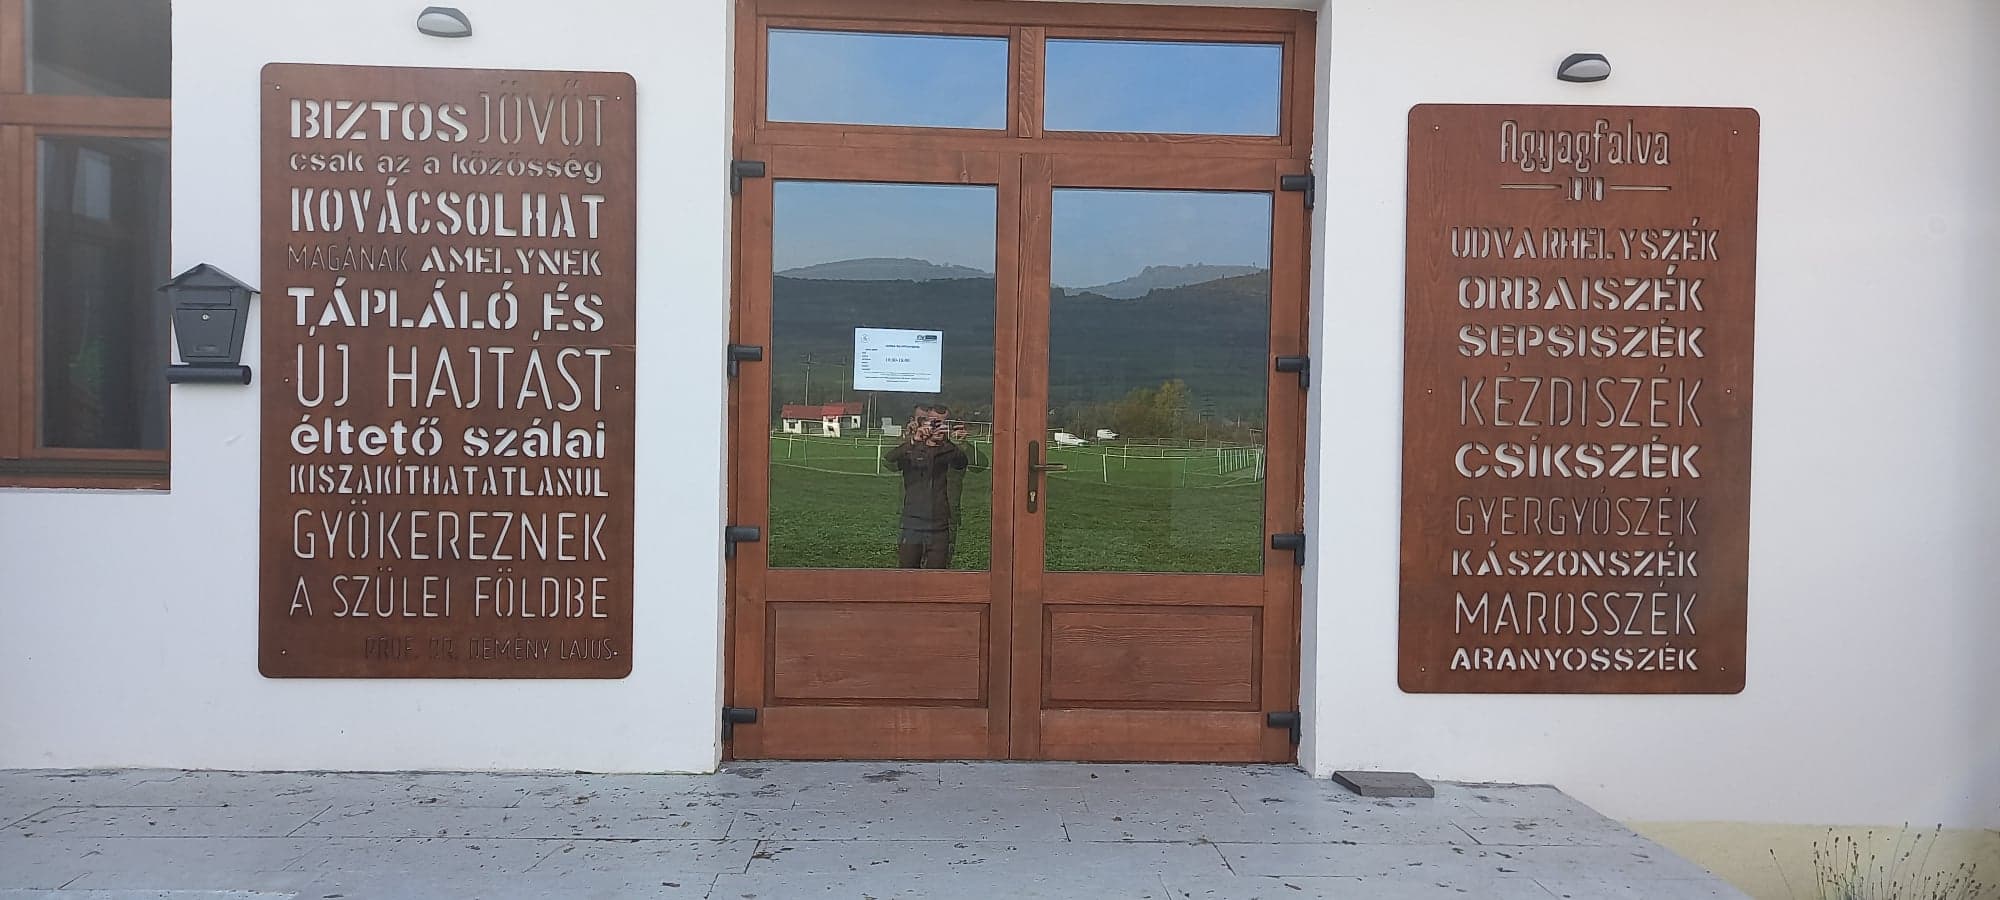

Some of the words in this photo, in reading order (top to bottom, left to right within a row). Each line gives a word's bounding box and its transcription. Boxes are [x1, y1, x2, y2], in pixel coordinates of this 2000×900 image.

[289, 98, 468, 142] BIZTOS
[478, 80, 607, 146] JÖVŐT
[289, 151, 364, 172] csak
[378, 155, 411, 174] az
[424, 156, 440, 174] a
[452, 151, 602, 183] közösség
[1500, 118, 1670, 172] Agyagfalva
[291, 178, 606, 239] KOVÁCSOLHAT
[288, 237, 408, 271] MAGÁNAK
[421, 246, 602, 276] AMELYNEK
[1451, 217, 1720, 260] UDVARHELYSZÉK
[288, 278, 518, 329] TÁPLÁLÓ
[543, 282, 604, 331] ÉS
[1458, 265, 1704, 311] ORBAISZÉK
[1458, 318, 1704, 358] SEPSISZÉK
[297, 326, 349, 407] ÚJ
[388, 331, 611, 411] HAJTÁST
[1461, 363, 1702, 427] KÉZDISZÉK
[291, 414, 442, 456] éltető
[464, 418, 606, 458] szálai
[1455, 434, 1701, 478] CSÍKSZÉK
[290, 459, 608, 497] KISZAKÍTHATATLANUL
[293, 499, 607, 561] GYÖKEREZNEK
[1455, 487, 1699, 537] GYERGYÓSZÉK
[1452, 541, 1698, 577] KÁSZONSZÉK
[290, 576, 313, 616] A
[332, 567, 450, 617] SZÜLEI
[475, 568, 608, 618] FÖLDBE
[1455, 581, 1696, 636] MAROSSZÉK
[1451, 642, 1698, 671] ARANYOSSZÉK
